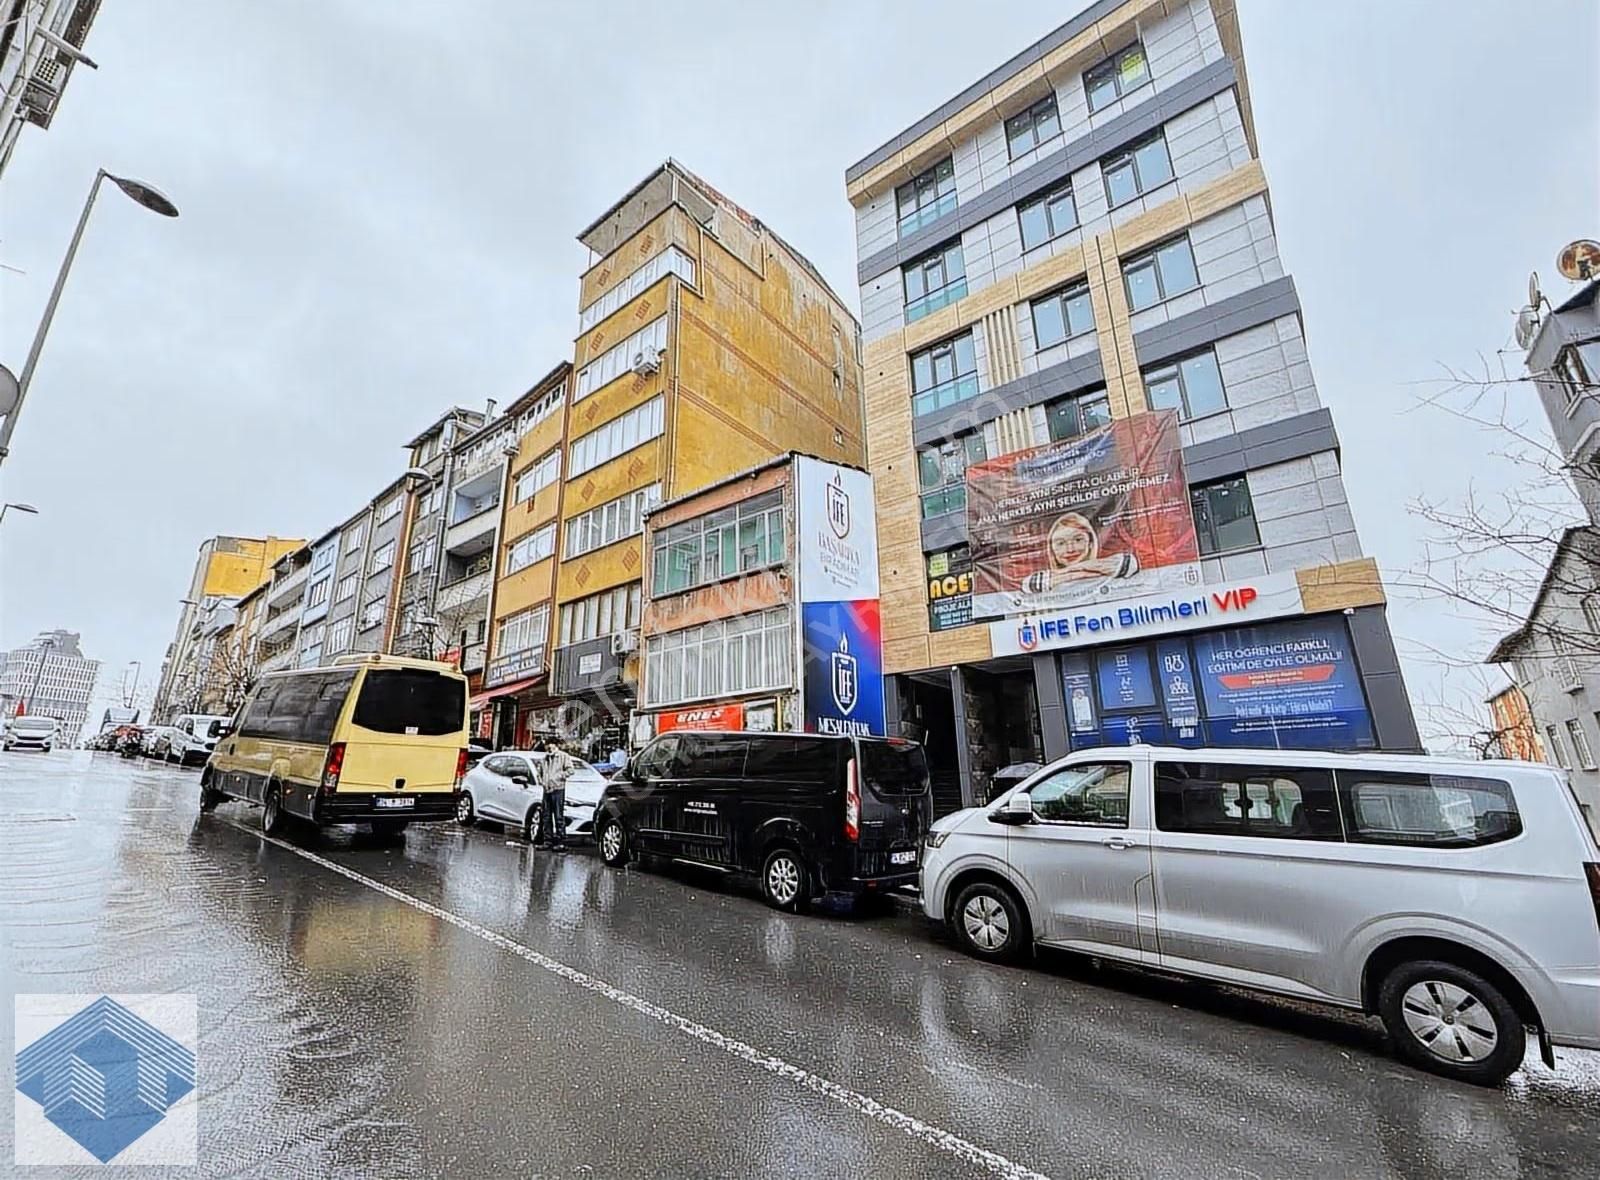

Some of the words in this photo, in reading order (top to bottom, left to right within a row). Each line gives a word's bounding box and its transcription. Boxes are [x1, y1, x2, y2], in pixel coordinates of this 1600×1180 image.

[1034, 501, 1056, 514] AYNI
[1057, 490, 1100, 508] ŞEKİLDE
[1075, 614, 1113, 634] Fen
[1118, 596, 1209, 627] Bilimleri
[1212, 587, 1258, 612] VIP
[1212, 649, 1234, 661] HER
[1246, 657, 1263, 670] DE
